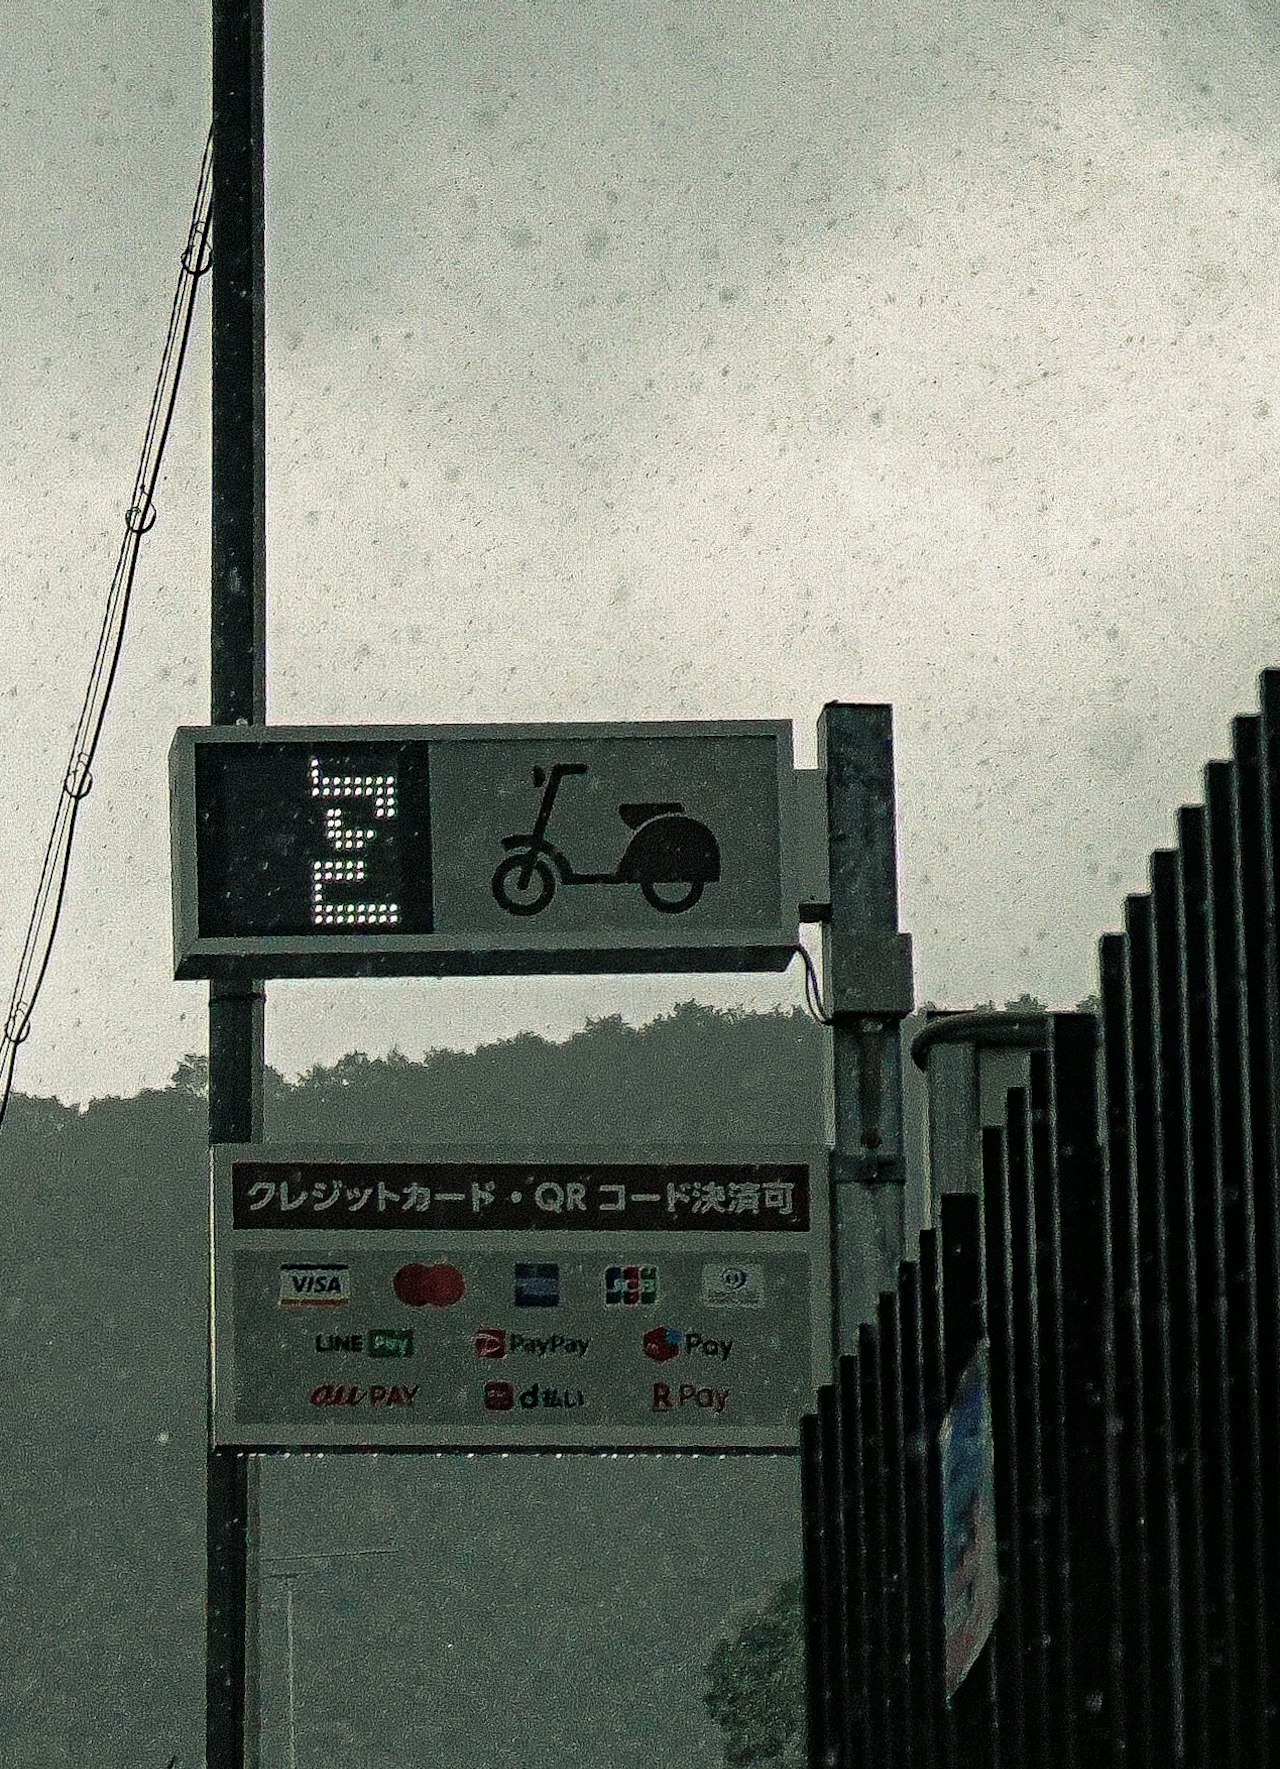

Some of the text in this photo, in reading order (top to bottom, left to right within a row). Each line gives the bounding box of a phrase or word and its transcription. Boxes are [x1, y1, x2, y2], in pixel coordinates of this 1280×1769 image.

[291, 1274, 341, 1294] VISA
[315, 1334, 409, 1356] LINE Pay
[511, 1332, 591, 1358] PayPay
[686, 1333, 733, 1361] Pay
[310, 1385, 419, 1407] au PAY
[519, 1383, 584, 1409] d払い
[678, 1384, 729, 1413] Pay
